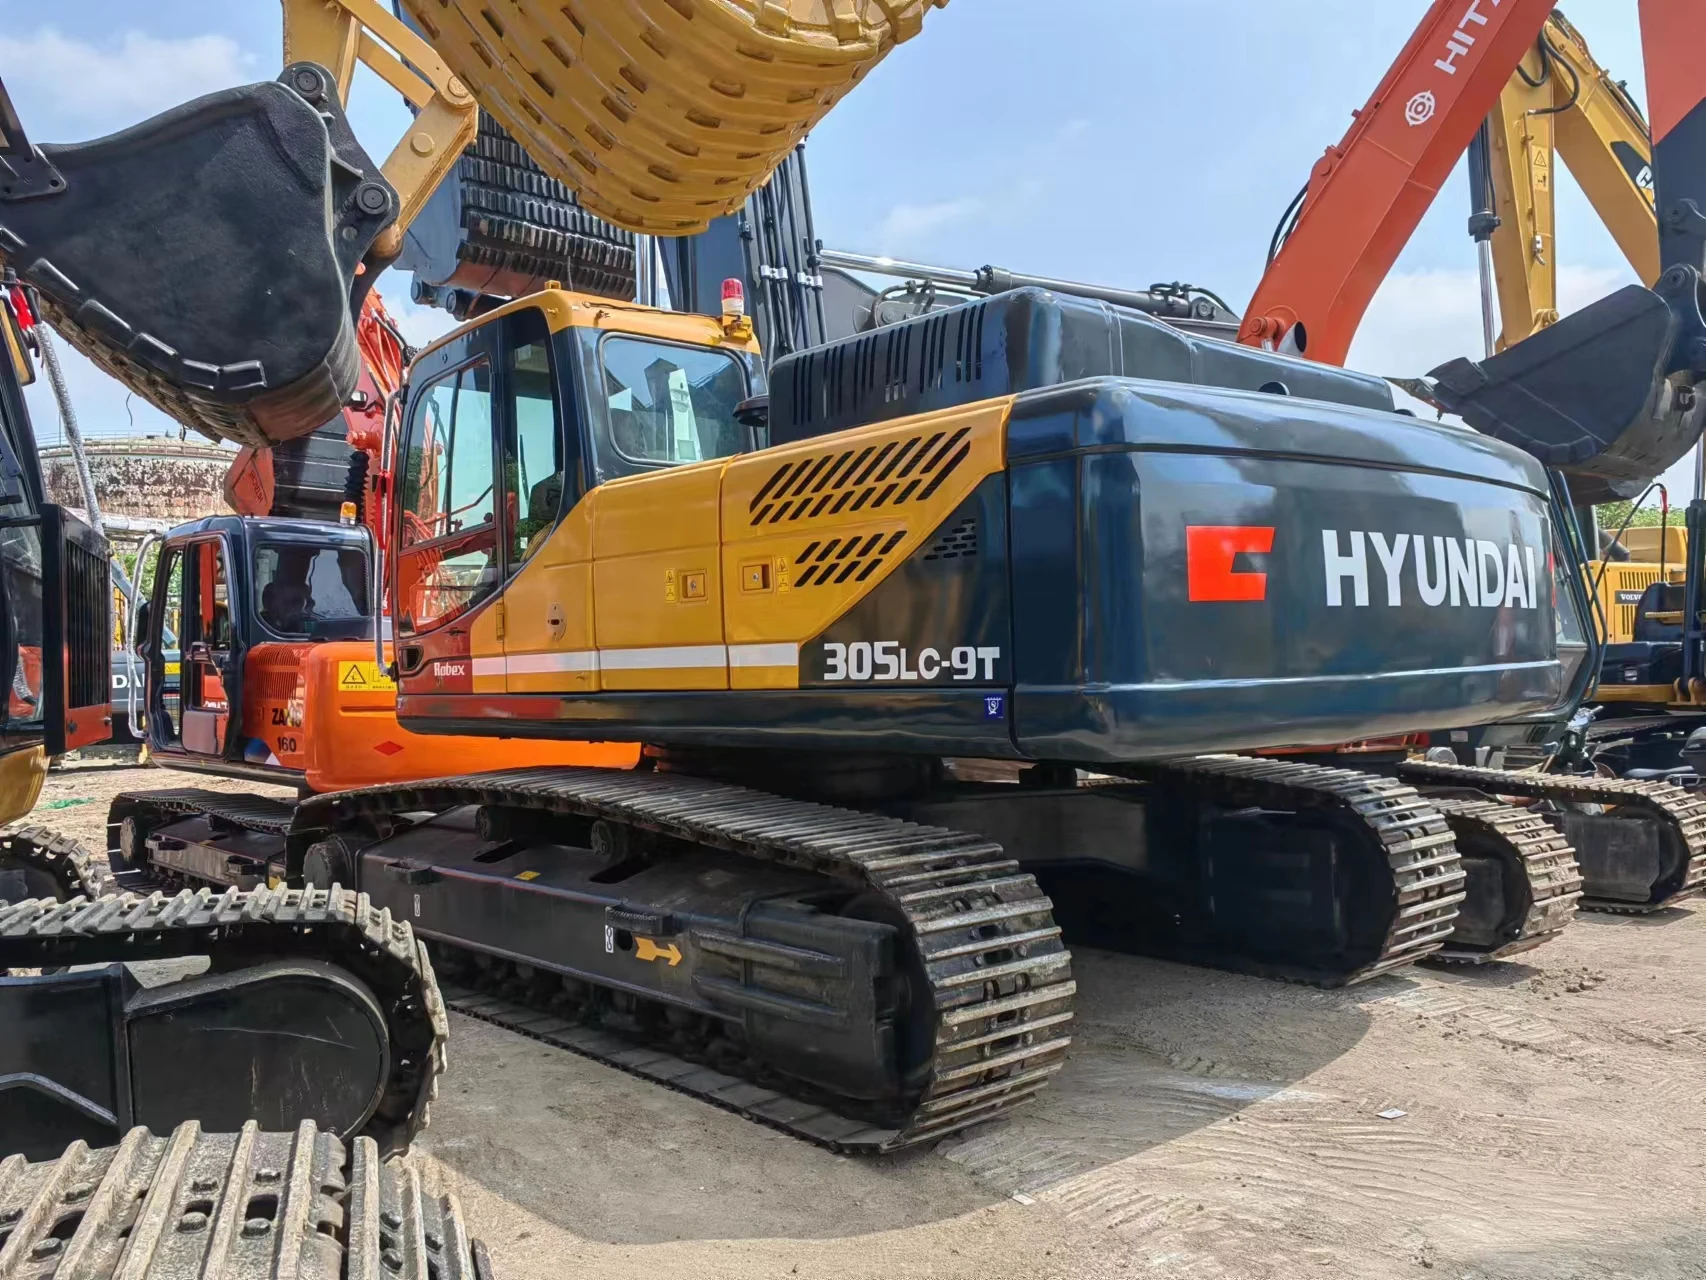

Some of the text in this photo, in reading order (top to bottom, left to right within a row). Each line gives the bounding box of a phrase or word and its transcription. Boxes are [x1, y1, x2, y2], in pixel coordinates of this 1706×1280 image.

[1433, 0, 1501, 75] HIT
[1322, 529, 1537, 610] HYUNDAI
[433, 661, 465, 677] Robex
[823, 641, 1000, 681] 305LC-9T
[277, 736, 297, 752] 160
